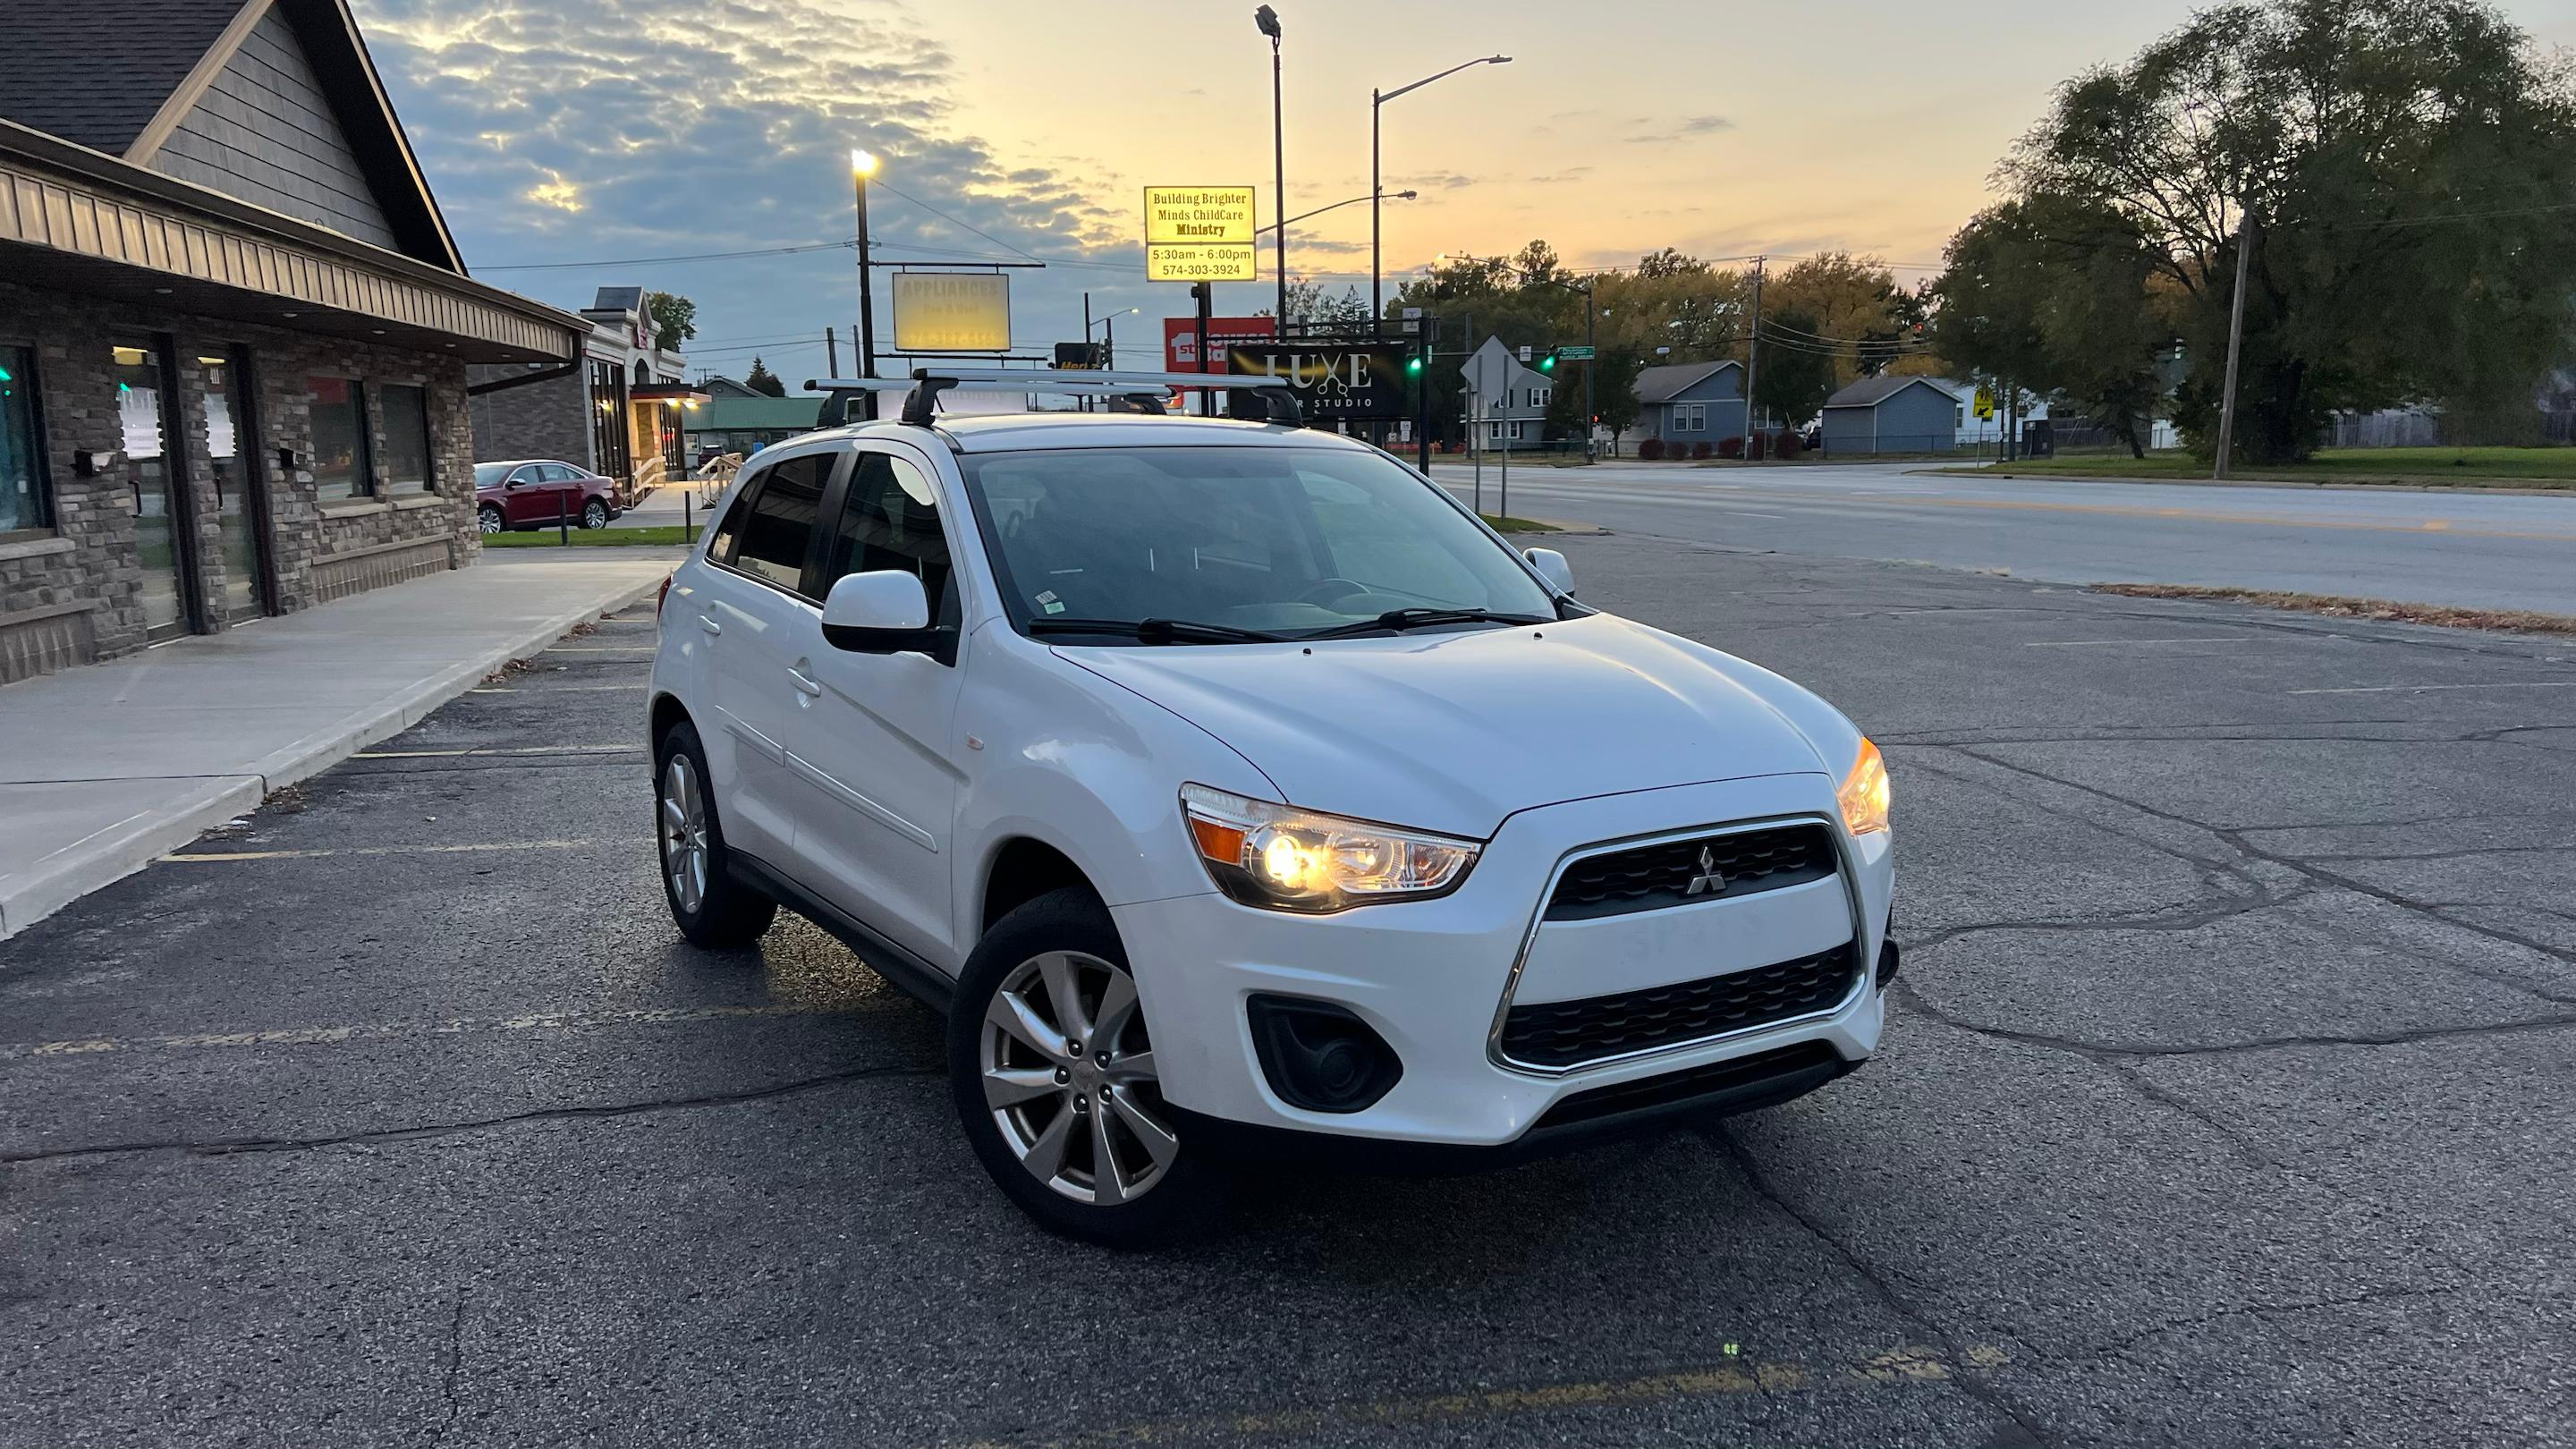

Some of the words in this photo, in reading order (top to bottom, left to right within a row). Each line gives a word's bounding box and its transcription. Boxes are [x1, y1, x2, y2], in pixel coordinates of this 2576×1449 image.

[1154, 193, 1200, 206] Building
[1202, 193, 1247, 206] Brighter
[1158, 210, 1191, 221] Minds
[1193, 209, 1243, 221] ChildCare
[1176, 224, 1225, 237] Ministry
[1153, 250, 1196, 260] 5:30am
[1208, 250, 1250, 261] 6:00pm
[1162, 265, 1241, 275] 574-303-3924
[902, 281, 999, 297] APPLIANCES
[209, 368, 220, 384] 411
[1314, 399, 1372, 408] STUDIO
